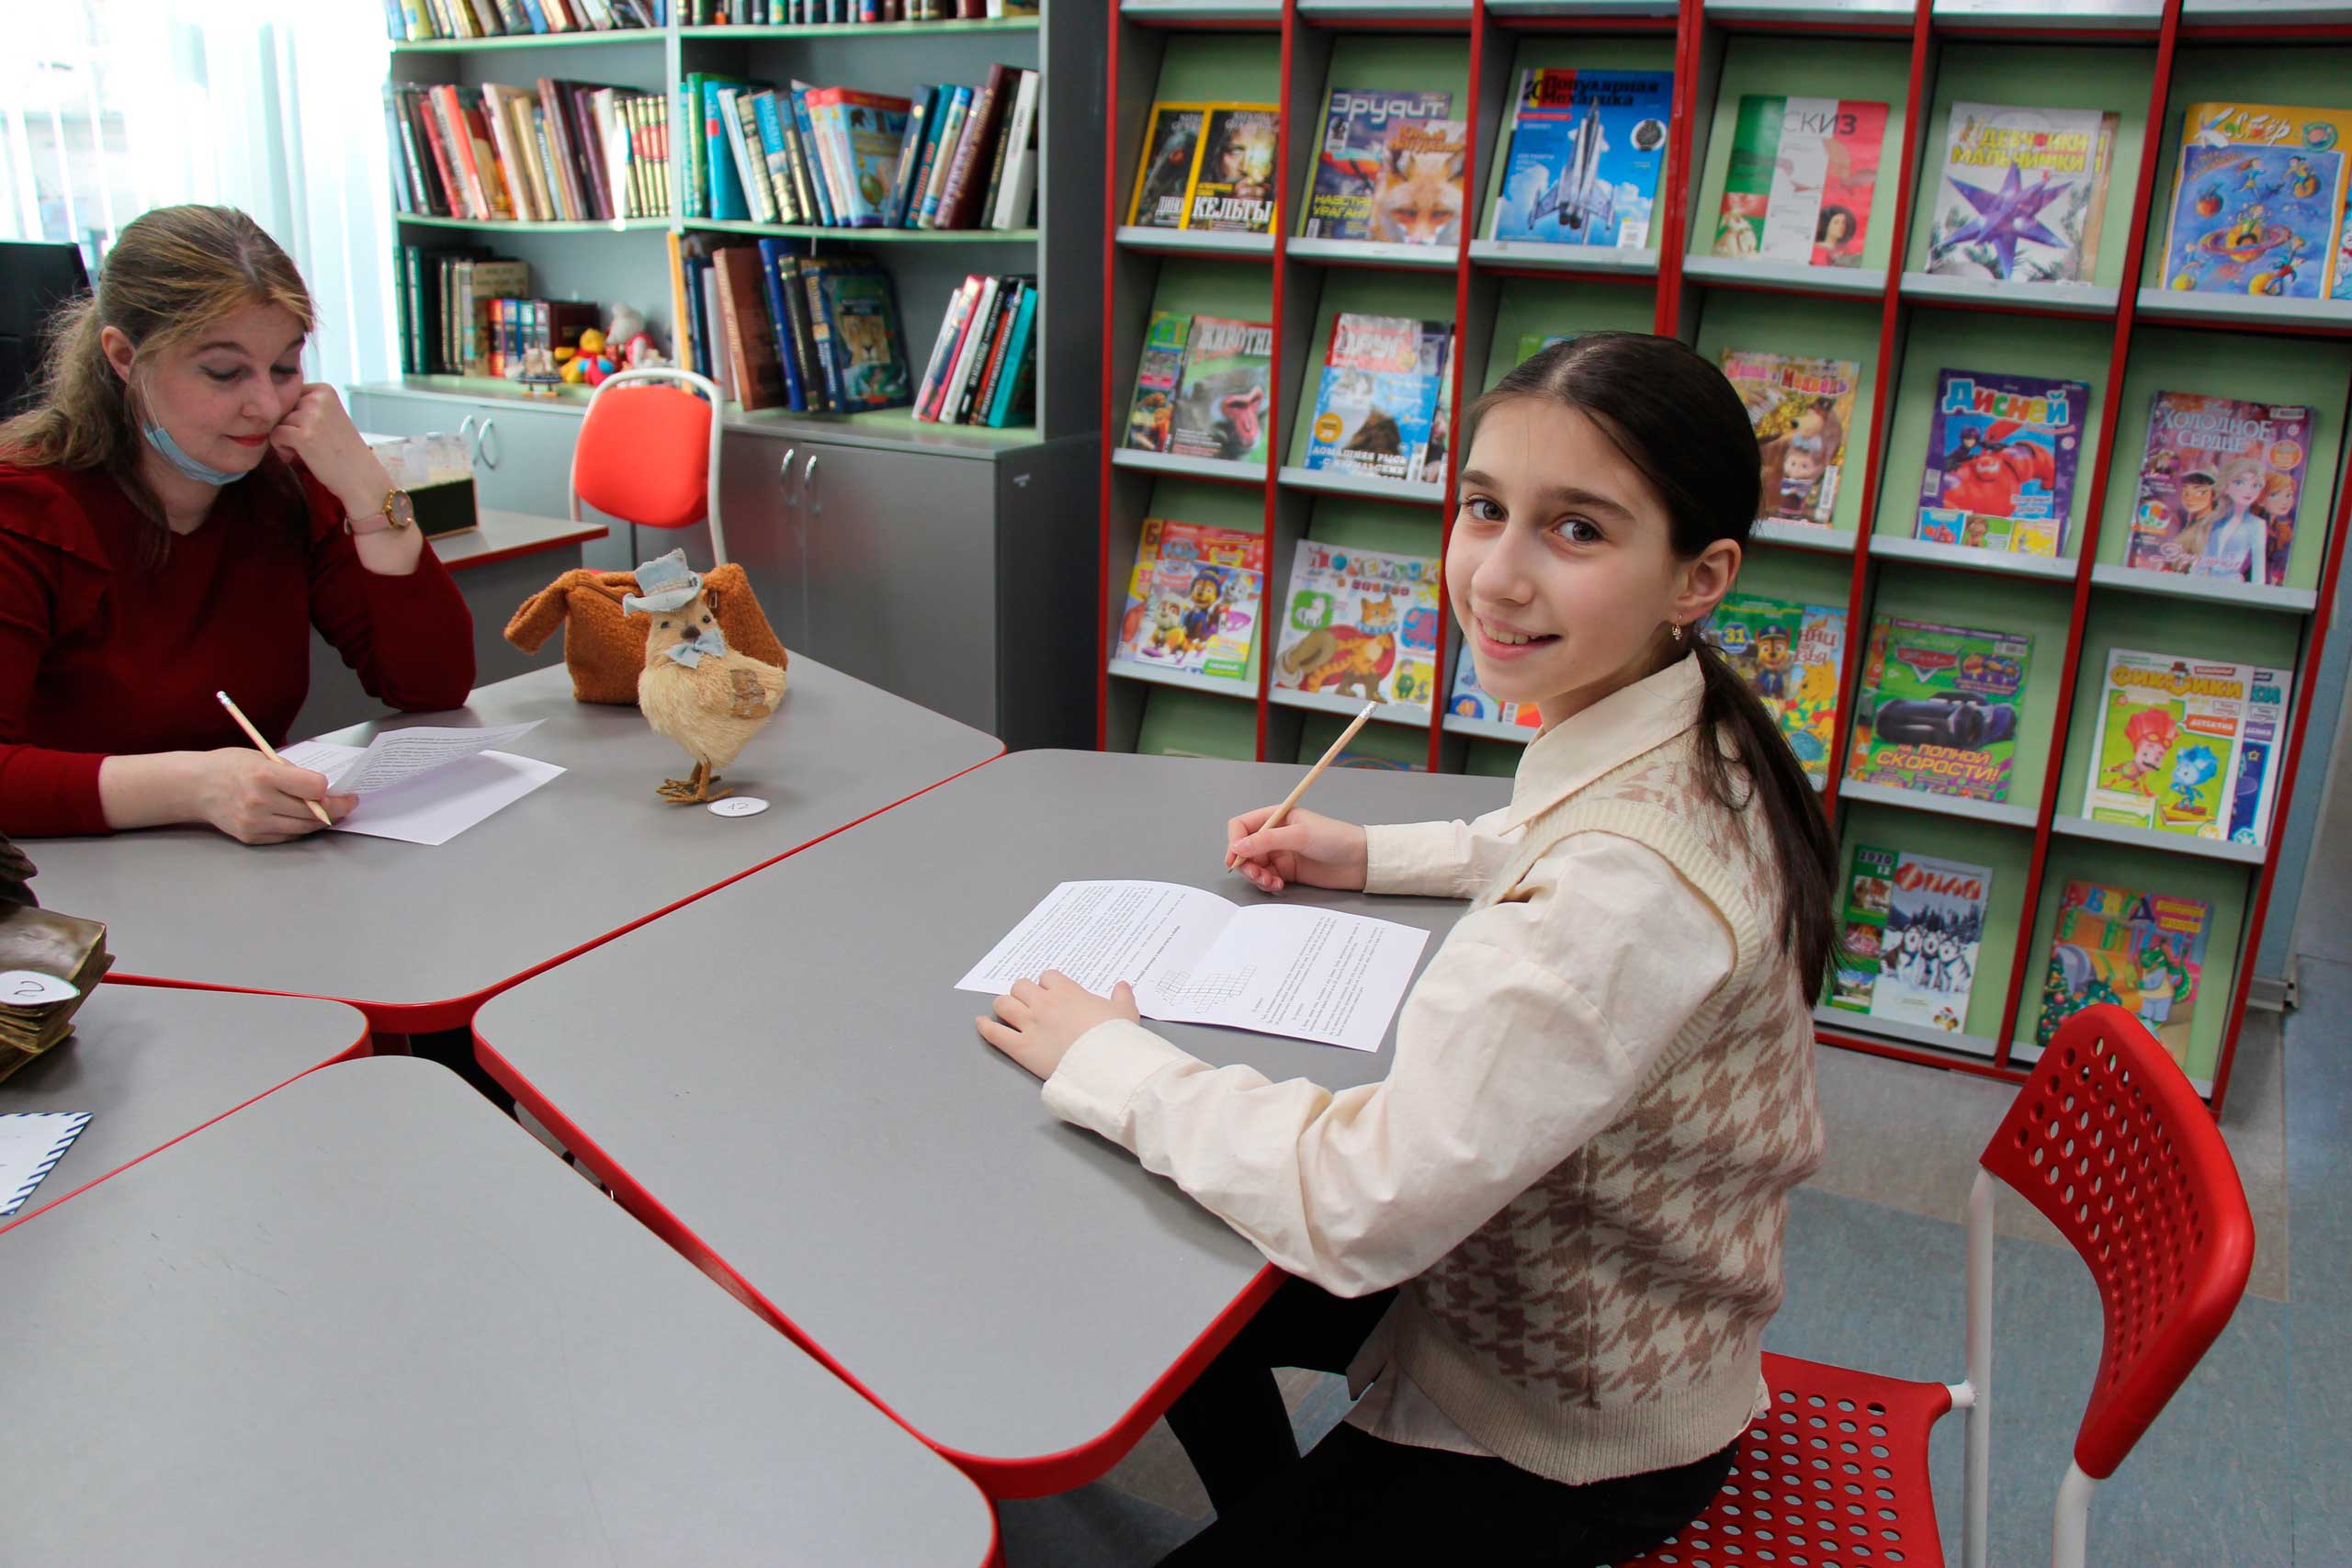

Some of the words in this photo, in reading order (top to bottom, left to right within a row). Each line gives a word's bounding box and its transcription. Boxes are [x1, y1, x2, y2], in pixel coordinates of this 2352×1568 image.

[1782, 109, 1858, 136] СКИЗ
[1192, 197, 1274, 221] КЕЛЬТЫ
[1942, 377, 2070, 425] Дисней
[2160, 409, 2274, 442] ХОЛОДНОЕ
[1724, 626, 1746, 644] 31
[1875, 750, 2001, 781] СКОРОСТИ!
[1917, 744, 1992, 766] ПОЛНОЙ
